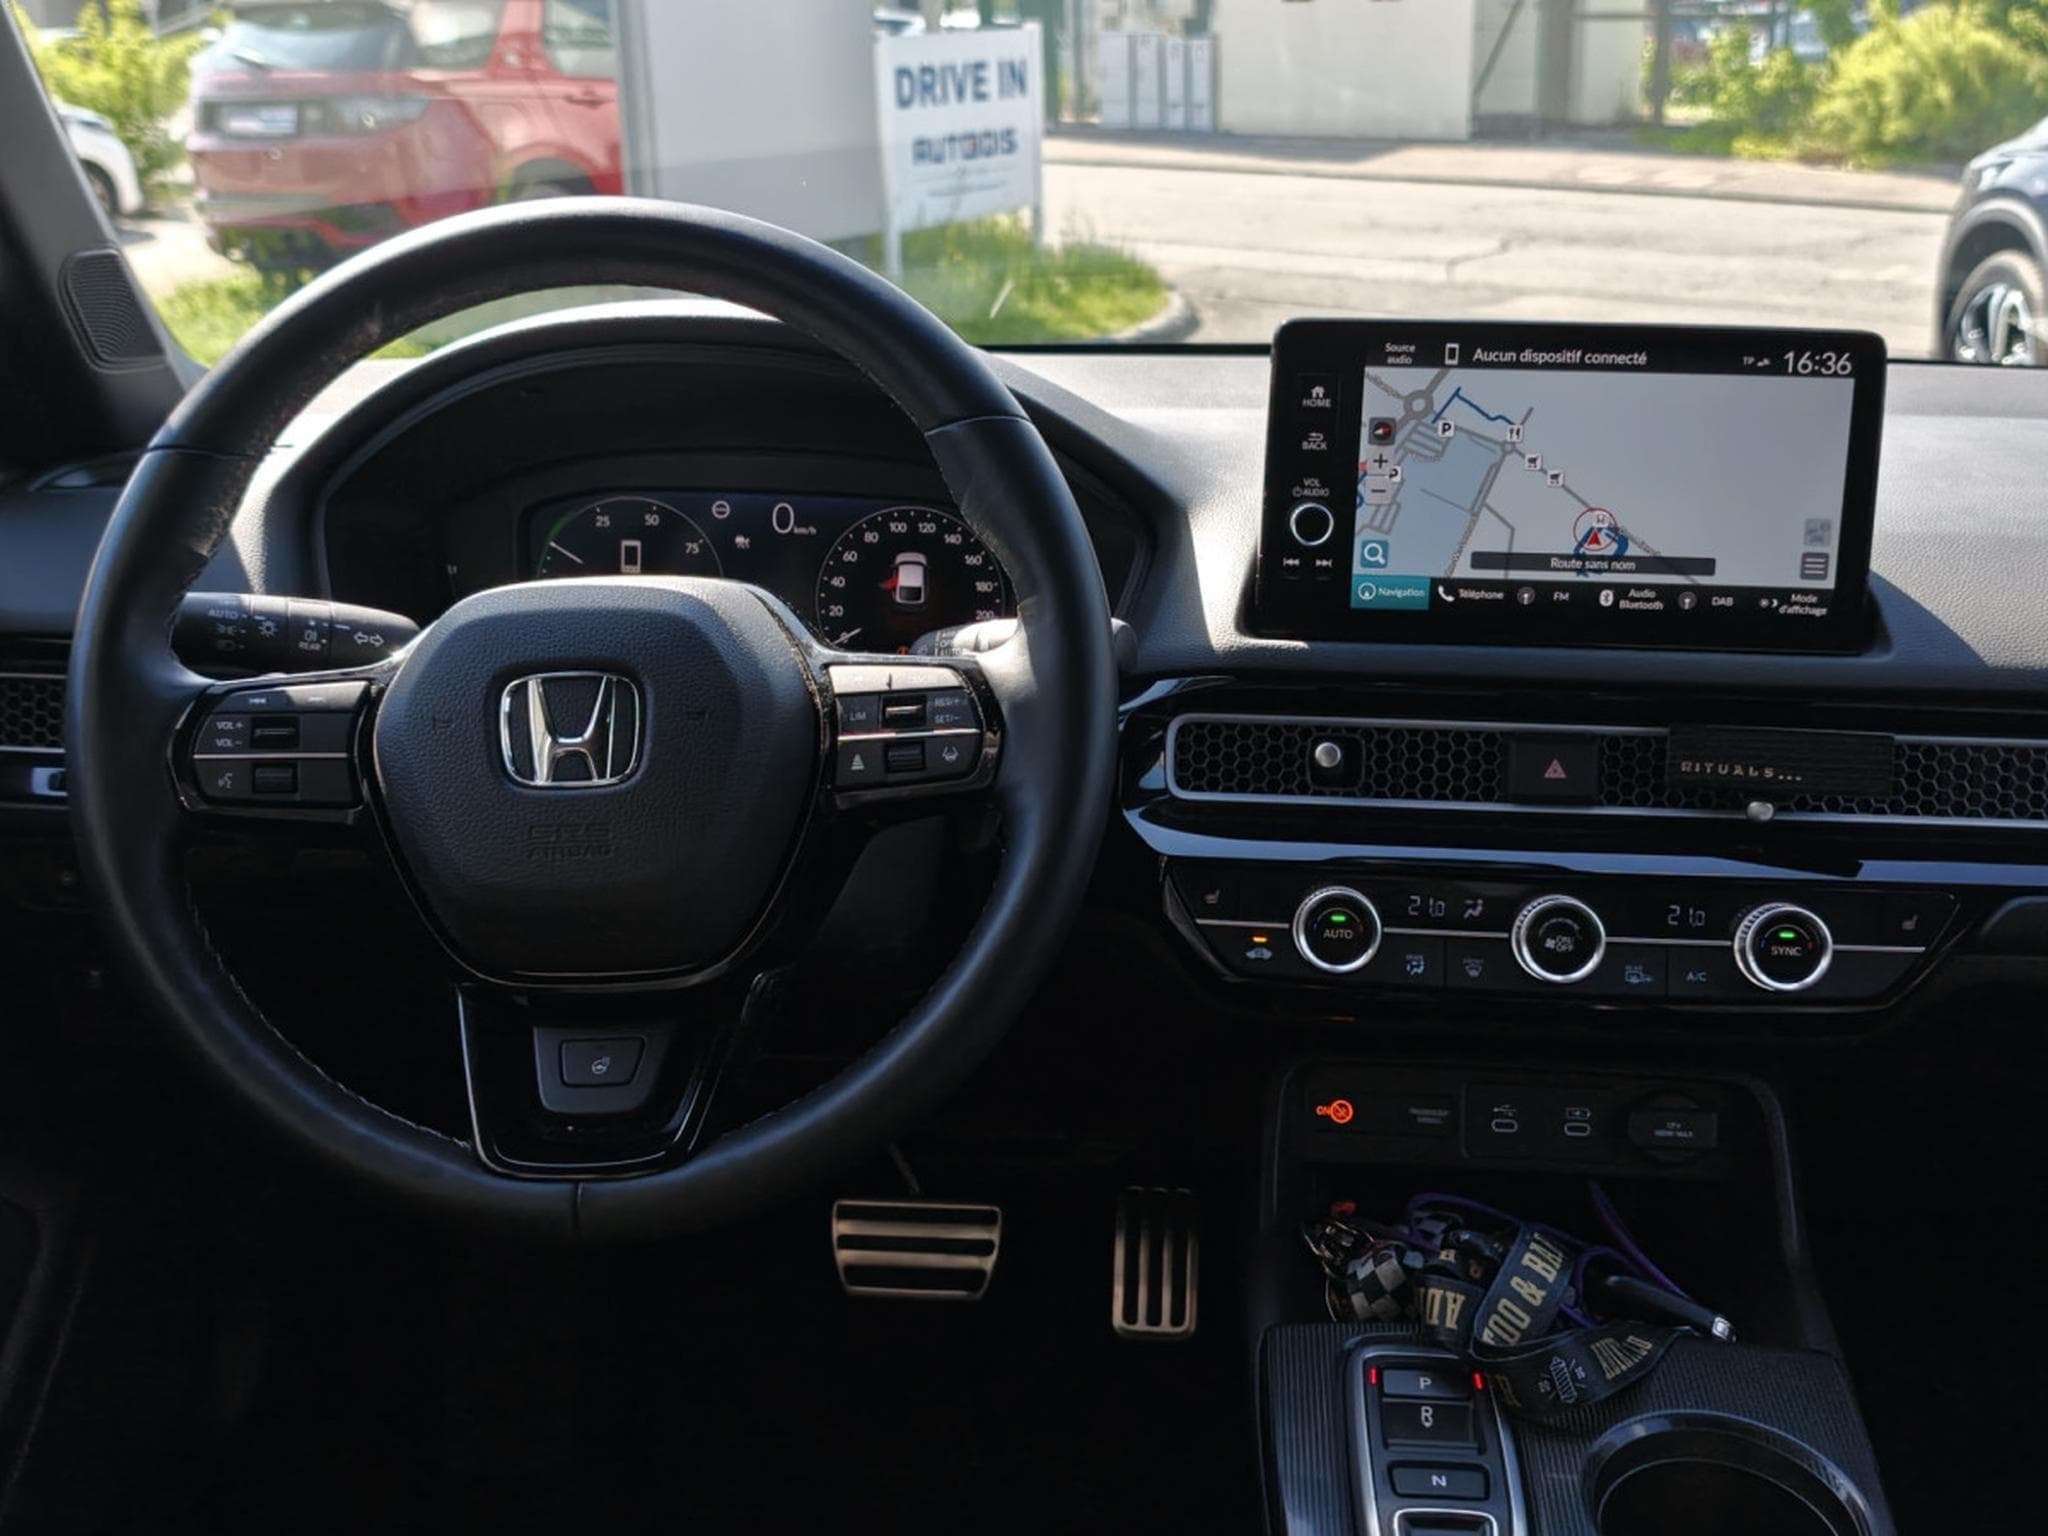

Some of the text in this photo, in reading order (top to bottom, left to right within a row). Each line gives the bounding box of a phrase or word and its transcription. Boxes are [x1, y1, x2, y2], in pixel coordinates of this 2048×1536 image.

[894, 60, 1027, 109] DRIVE IN
[1384, 342, 1416, 352] Source
[1386, 354, 1413, 365] audio
[1472, 349, 1647, 365] Aucun dispositif connecté
[1783, 351, 1852, 375] 16:36
[1302, 398, 1332, 408] HOME
[1301, 440, 1327, 450] BACK
[1304, 479, 1320, 487] VOL
[595, 514, 610, 527] 25
[644, 513, 660, 526] 50
[772, 503, 794, 534] 0
[889, 522, 907, 533] 100
[918, 522, 936, 533] 120
[864, 532, 878, 543] 80
[944, 534, 962, 544] 140
[685, 542, 699, 554] 75
[843, 551, 857, 562] 60
[964, 554, 982, 566] 160
[1550, 558, 1636, 571] Route sans nom
[830, 577, 845, 587] 40
[975, 582, 993, 593] 180
[1378, 586, 1426, 599] Navigation
[1553, 591, 1570, 601] FM
[1628, 587, 1656, 598] Audio
[1712, 596, 1733, 607] DAB
[1791, 593, 1818, 604] Mode
[1619, 600, 1663, 611] Bluetooth
[208, 608, 239, 619] AUTO
[829, 606, 843, 617] 20
[975, 610, 994, 620] 200
[298, 641, 321, 651] REAR
[850, 712, 867, 721] LIM
[215, 721, 234, 731] VOL
[215, 738, 233, 747] VOL
[1680, 761, 1803, 781] RITUALS...
[1323, 928, 1354, 940] AUTO
[1770, 944, 1803, 957] SYNC
[1686, 970, 1707, 982] A/C
[1419, 1377, 1432, 1389] P
[1431, 1474, 1448, 1487] N
